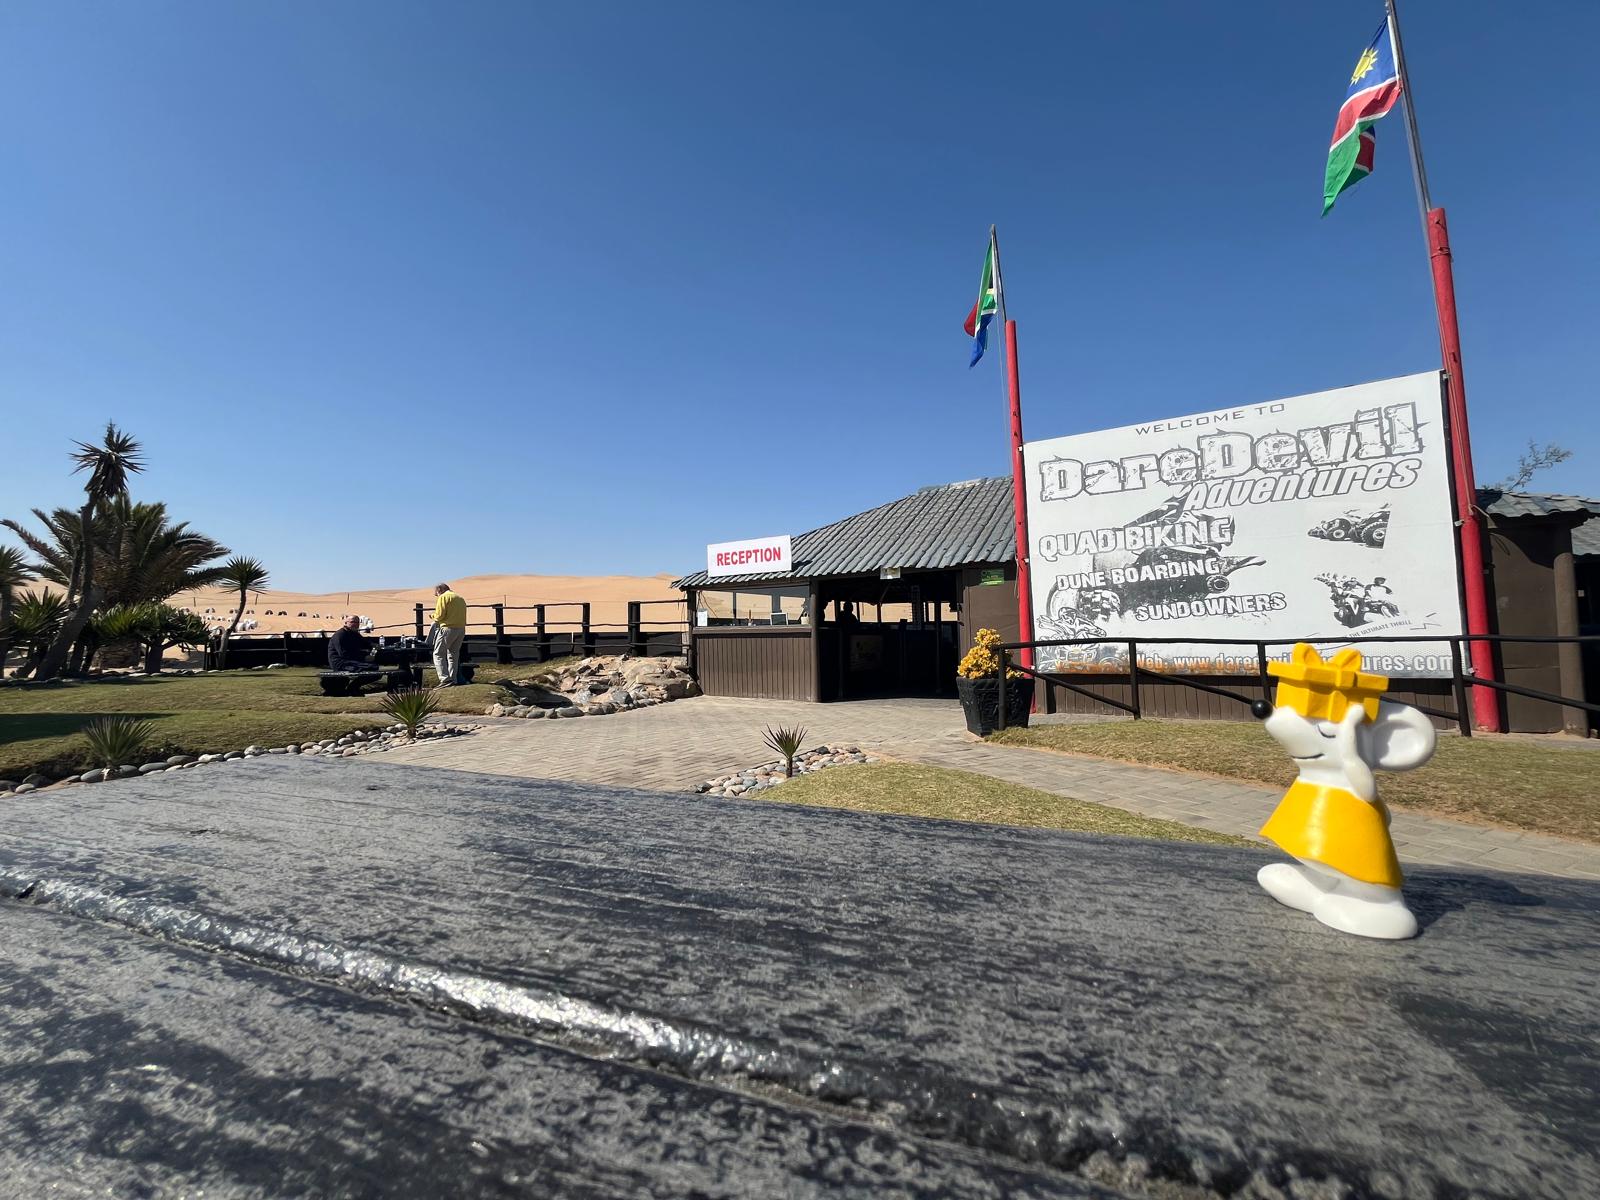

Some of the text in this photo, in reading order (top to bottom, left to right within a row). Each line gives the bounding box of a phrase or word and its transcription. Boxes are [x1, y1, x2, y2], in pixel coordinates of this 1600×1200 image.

[1135, 403, 1285, 436] WELCOME TO
[1040, 402, 1426, 502] DareDevil
[1183, 458, 1422, 511] Adventures
[1038, 517, 1231, 561] QUAD BIKING
[716, 546, 781, 567] RECEPTION
[1055, 557, 1220, 591] DUNE BOARDING
[1136, 592, 1287, 621] SUNDOWNERS
[1361, 623, 1389, 635] ULTIMATE
